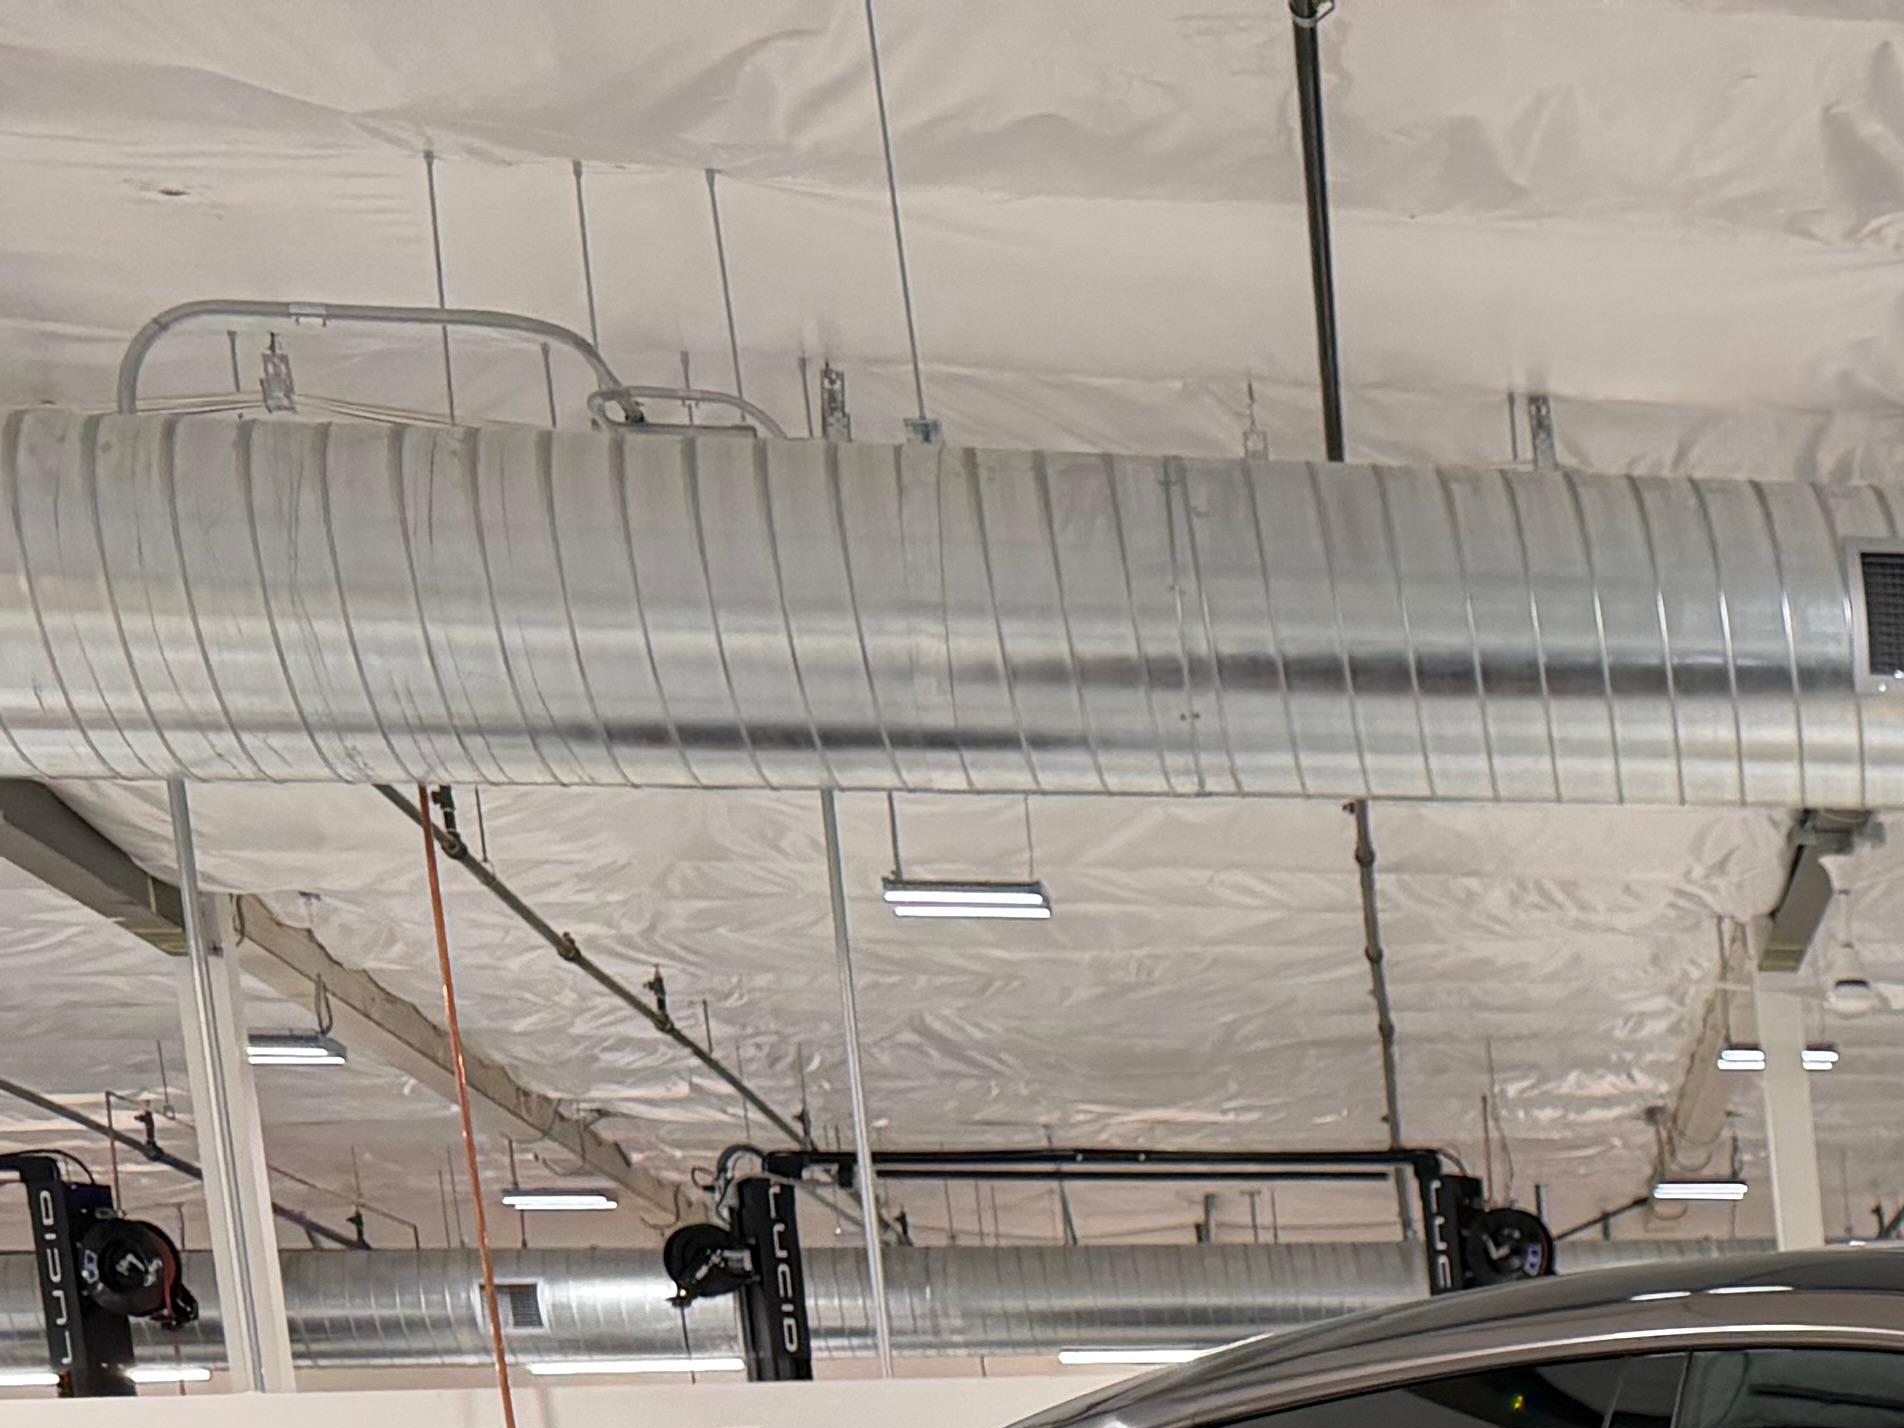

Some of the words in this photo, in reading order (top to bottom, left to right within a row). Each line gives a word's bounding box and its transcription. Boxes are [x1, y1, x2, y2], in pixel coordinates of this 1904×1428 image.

[40, 1190, 72, 1364] LUCID
[769, 1185, 798, 1353] LUCID
[1430, 1180, 1451, 1288] LUC
